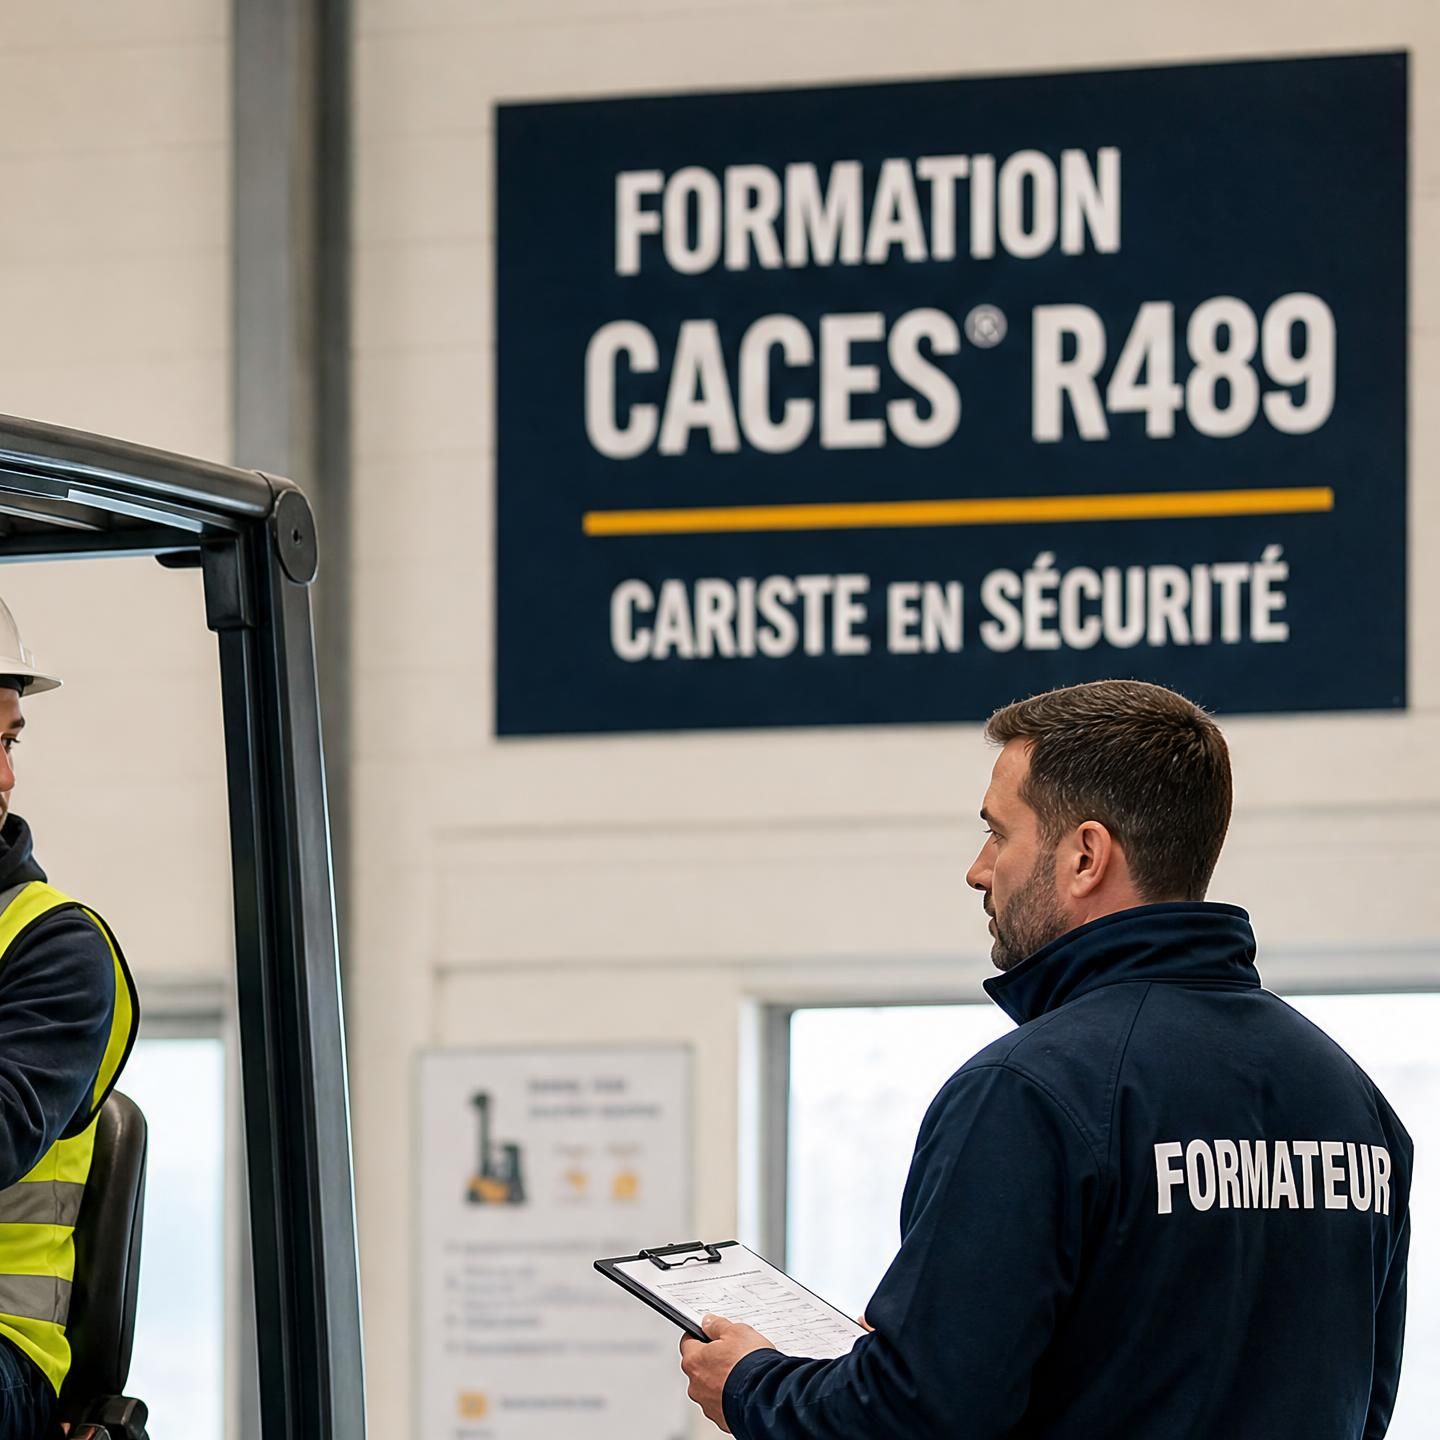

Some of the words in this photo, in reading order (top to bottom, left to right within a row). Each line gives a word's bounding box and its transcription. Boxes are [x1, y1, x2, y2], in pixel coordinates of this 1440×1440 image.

[616, 147, 1121, 275] FORMATION
[1032, 292, 1336, 442] R489
[611, 574, 870, 660] CARISTE
[887, 581, 963, 653] EN
[980, 545, 1289, 651] SÉCURITÉ
[1153, 1138, 1392, 1216] FORMATEUR
